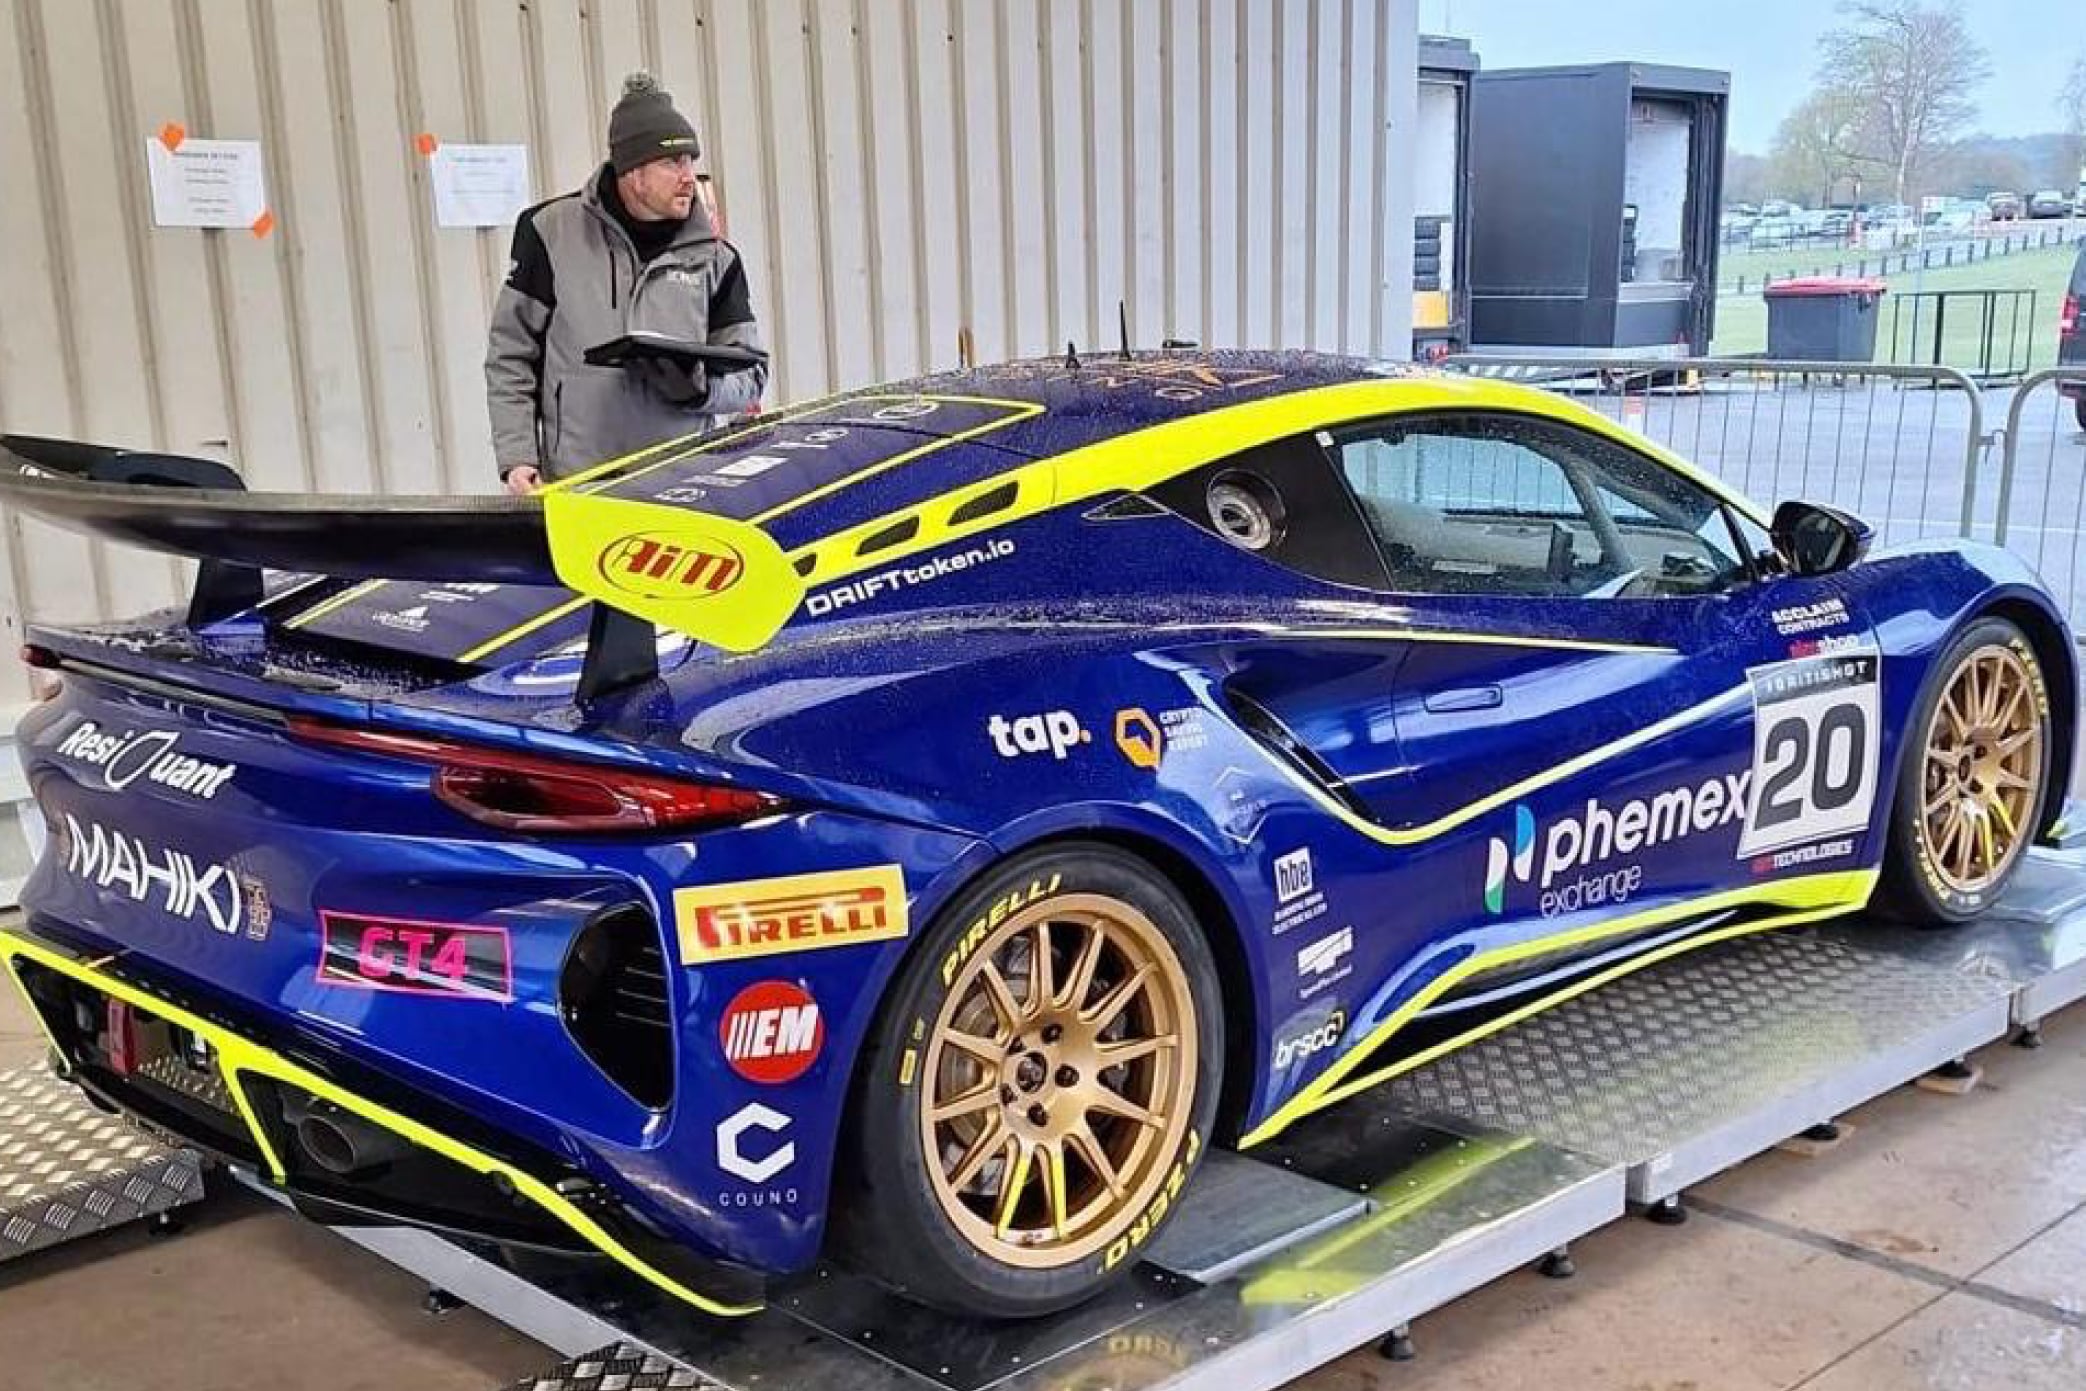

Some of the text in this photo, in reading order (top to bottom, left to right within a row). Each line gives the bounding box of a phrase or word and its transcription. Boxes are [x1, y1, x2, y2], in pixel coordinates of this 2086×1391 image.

[806, 538, 1016, 616] DRIFTtoken.io
[57, 722, 237, 799] ResiQuant
[988, 709, 1092, 759] tap.
[1754, 703, 1866, 831] 20
[1541, 770, 1752, 889] phemex
[694, 887, 886, 949] PIRELLI
[1540, 865, 1643, 918] exchange
[358, 926, 468, 983] GT4
[942, 873, 1062, 986] PIRELLI
[718, 1188, 798, 1207] COUNO
